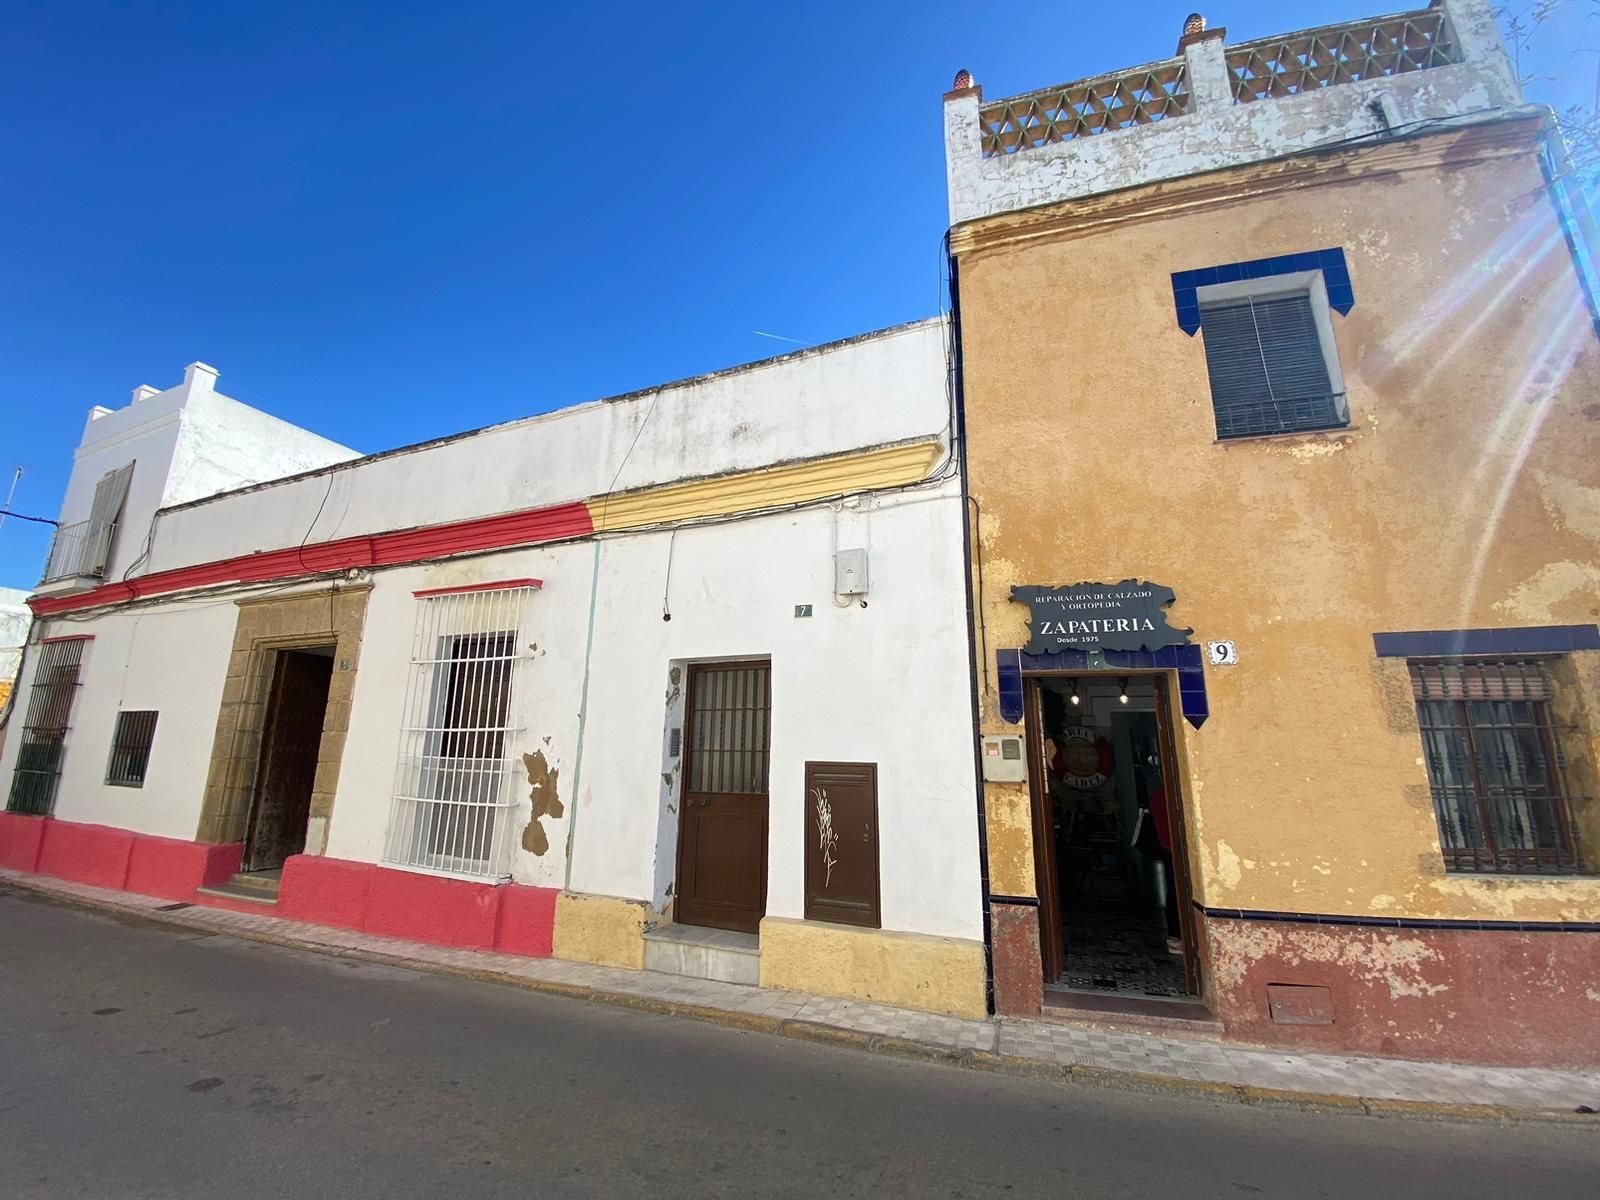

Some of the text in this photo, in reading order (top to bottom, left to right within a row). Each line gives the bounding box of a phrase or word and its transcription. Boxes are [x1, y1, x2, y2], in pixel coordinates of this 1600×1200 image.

[1094, 592, 1106, 600] DE
[1107, 590, 1152, 600] CALZADO
[1061, 601, 1122, 611] Y ORTOPEDIA
[1040, 617, 1156, 635] ZAPATERIA
[1215, 644, 1228, 661] 9
